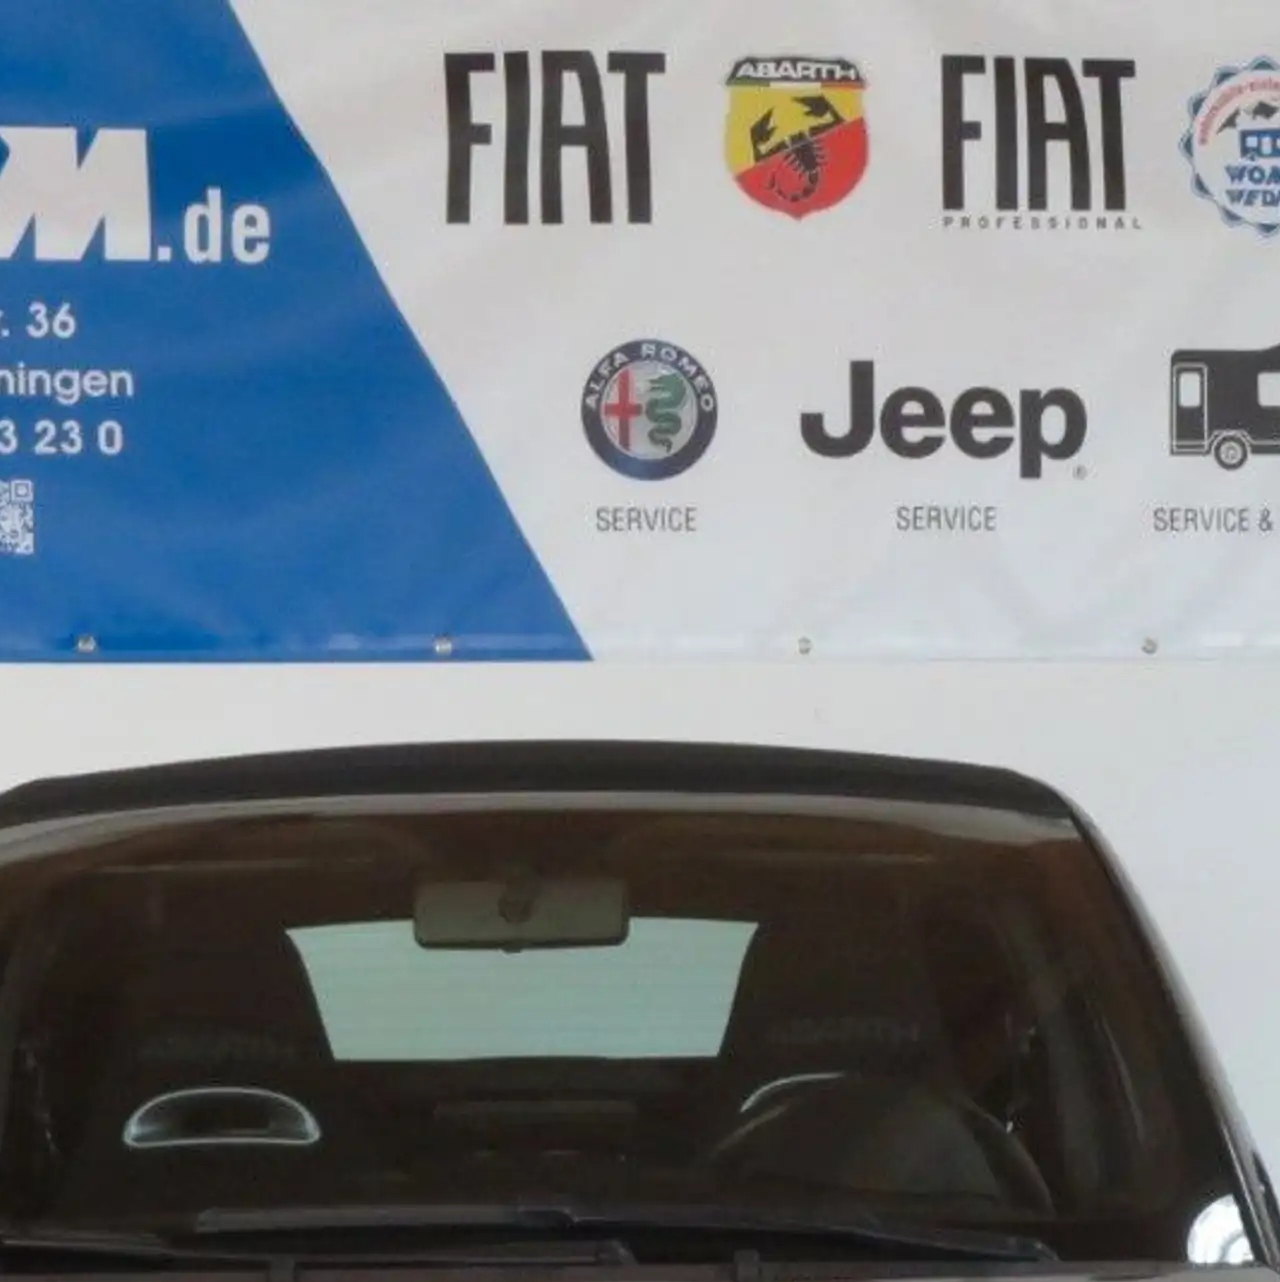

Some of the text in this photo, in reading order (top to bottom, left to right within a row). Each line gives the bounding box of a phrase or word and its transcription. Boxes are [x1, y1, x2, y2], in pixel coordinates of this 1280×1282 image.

[734, 60, 859, 82] ABARTH
[443, 50, 666, 225] FIAT
[941, 54, 1136, 212] FIAT
[942, 215, 1143, 231] PROFESSIONAL
[25, 301, 77, 339] 36
[585, 342, 714, 412] ALFA ROMEO
[33, 419, 84, 456] 23
[97, 419, 124, 456] 0
[800, 360, 1088, 480] Jeep
[595, 505, 698, 533] SERVICE
[895, 505, 997, 532] SERVICE
[1152, 507, 1250, 533] SERVICE
[1257, 507, 1275, 533] &
